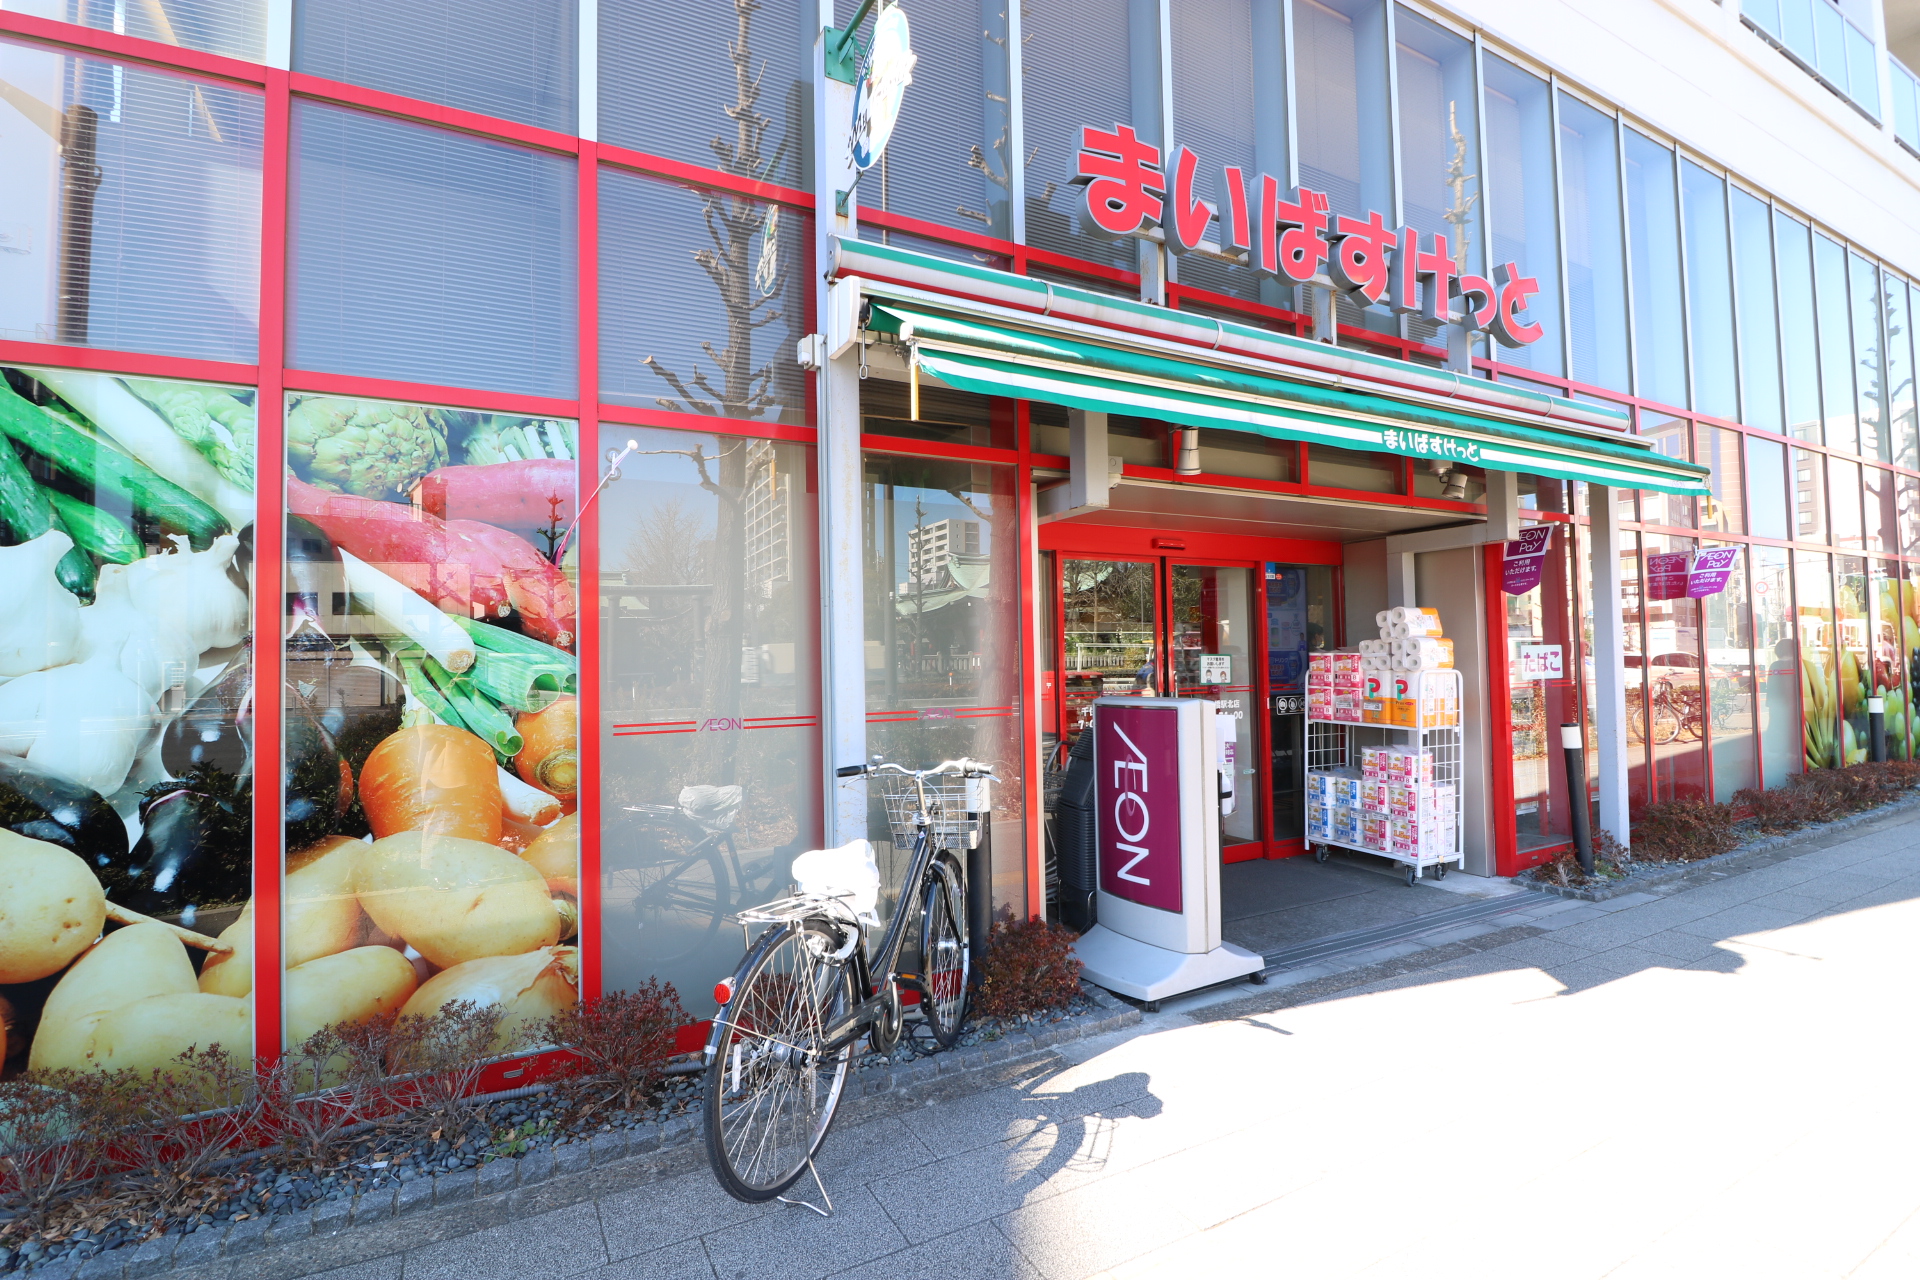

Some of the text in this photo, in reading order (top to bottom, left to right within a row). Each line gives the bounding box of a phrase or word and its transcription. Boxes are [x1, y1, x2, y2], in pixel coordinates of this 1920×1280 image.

[1070, 122, 1545, 348] まいばすけっと
[1383, 429, 1479, 462] まいばすけっと
[1519, 529, 1546, 541] EON
[1519, 541, 1541, 553] Pay
[1513, 559, 1531, 567] ご利用
[1706, 559, 1729, 568] Pay
[1523, 651, 1561, 672] たばこ
